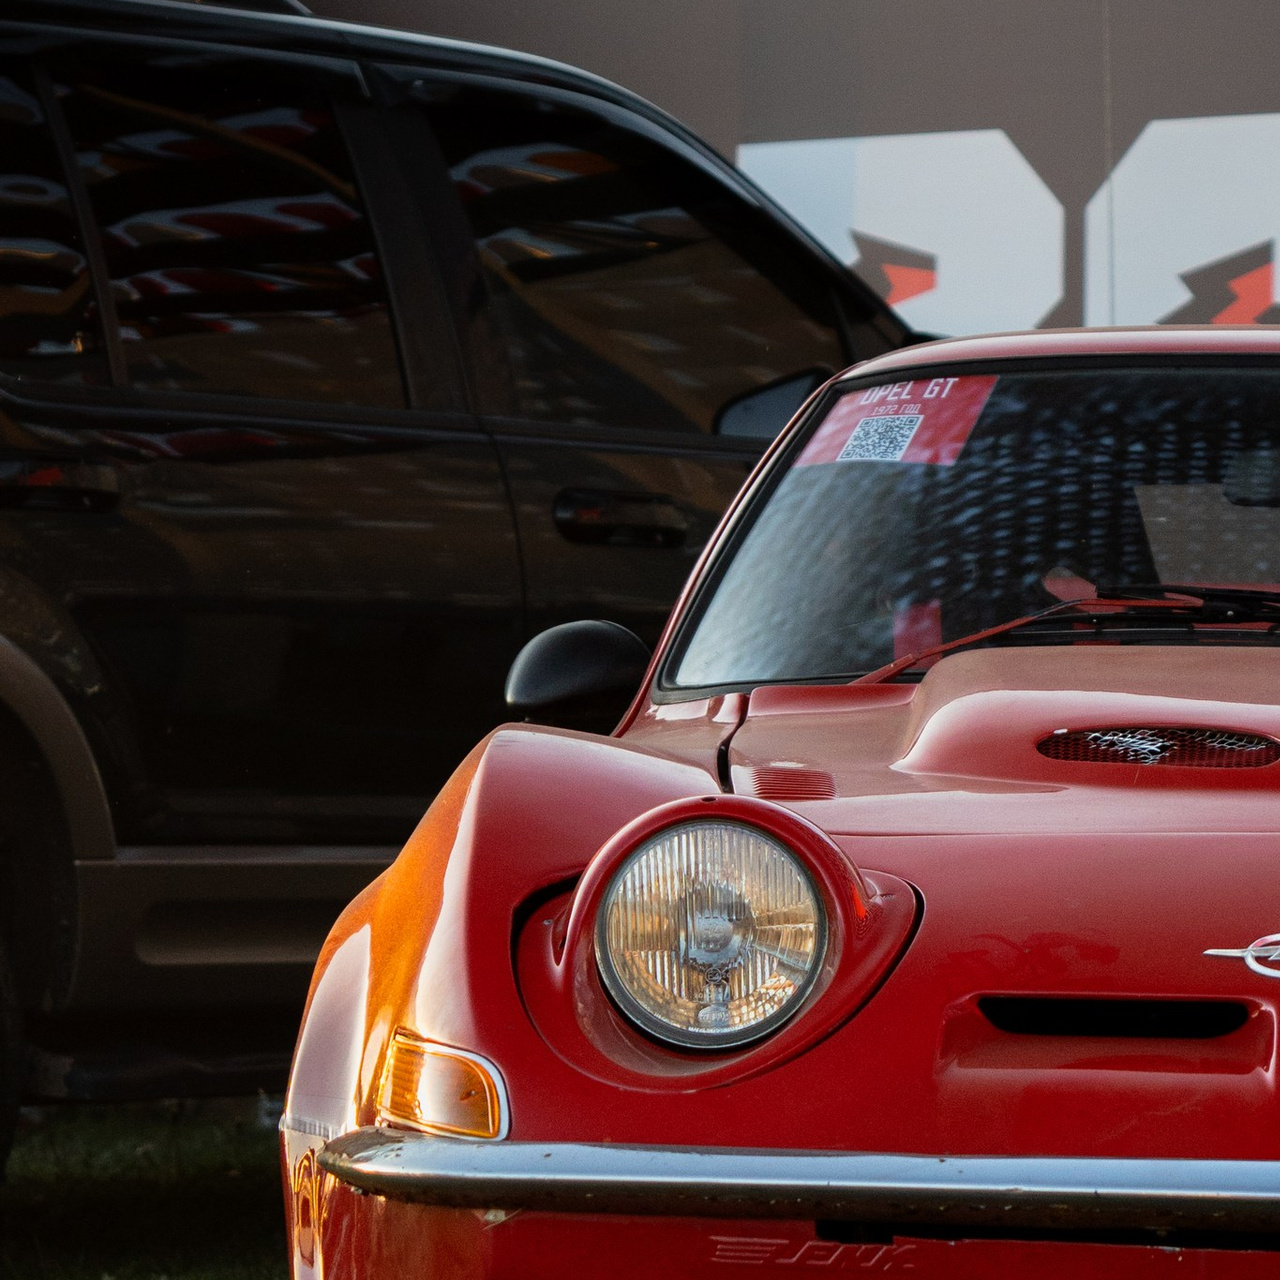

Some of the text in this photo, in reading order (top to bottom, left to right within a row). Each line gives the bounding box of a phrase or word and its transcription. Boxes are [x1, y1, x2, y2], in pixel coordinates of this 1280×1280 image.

[860, 378, 959, 405] OPEL GT
[871, 405, 898, 415] 1972
